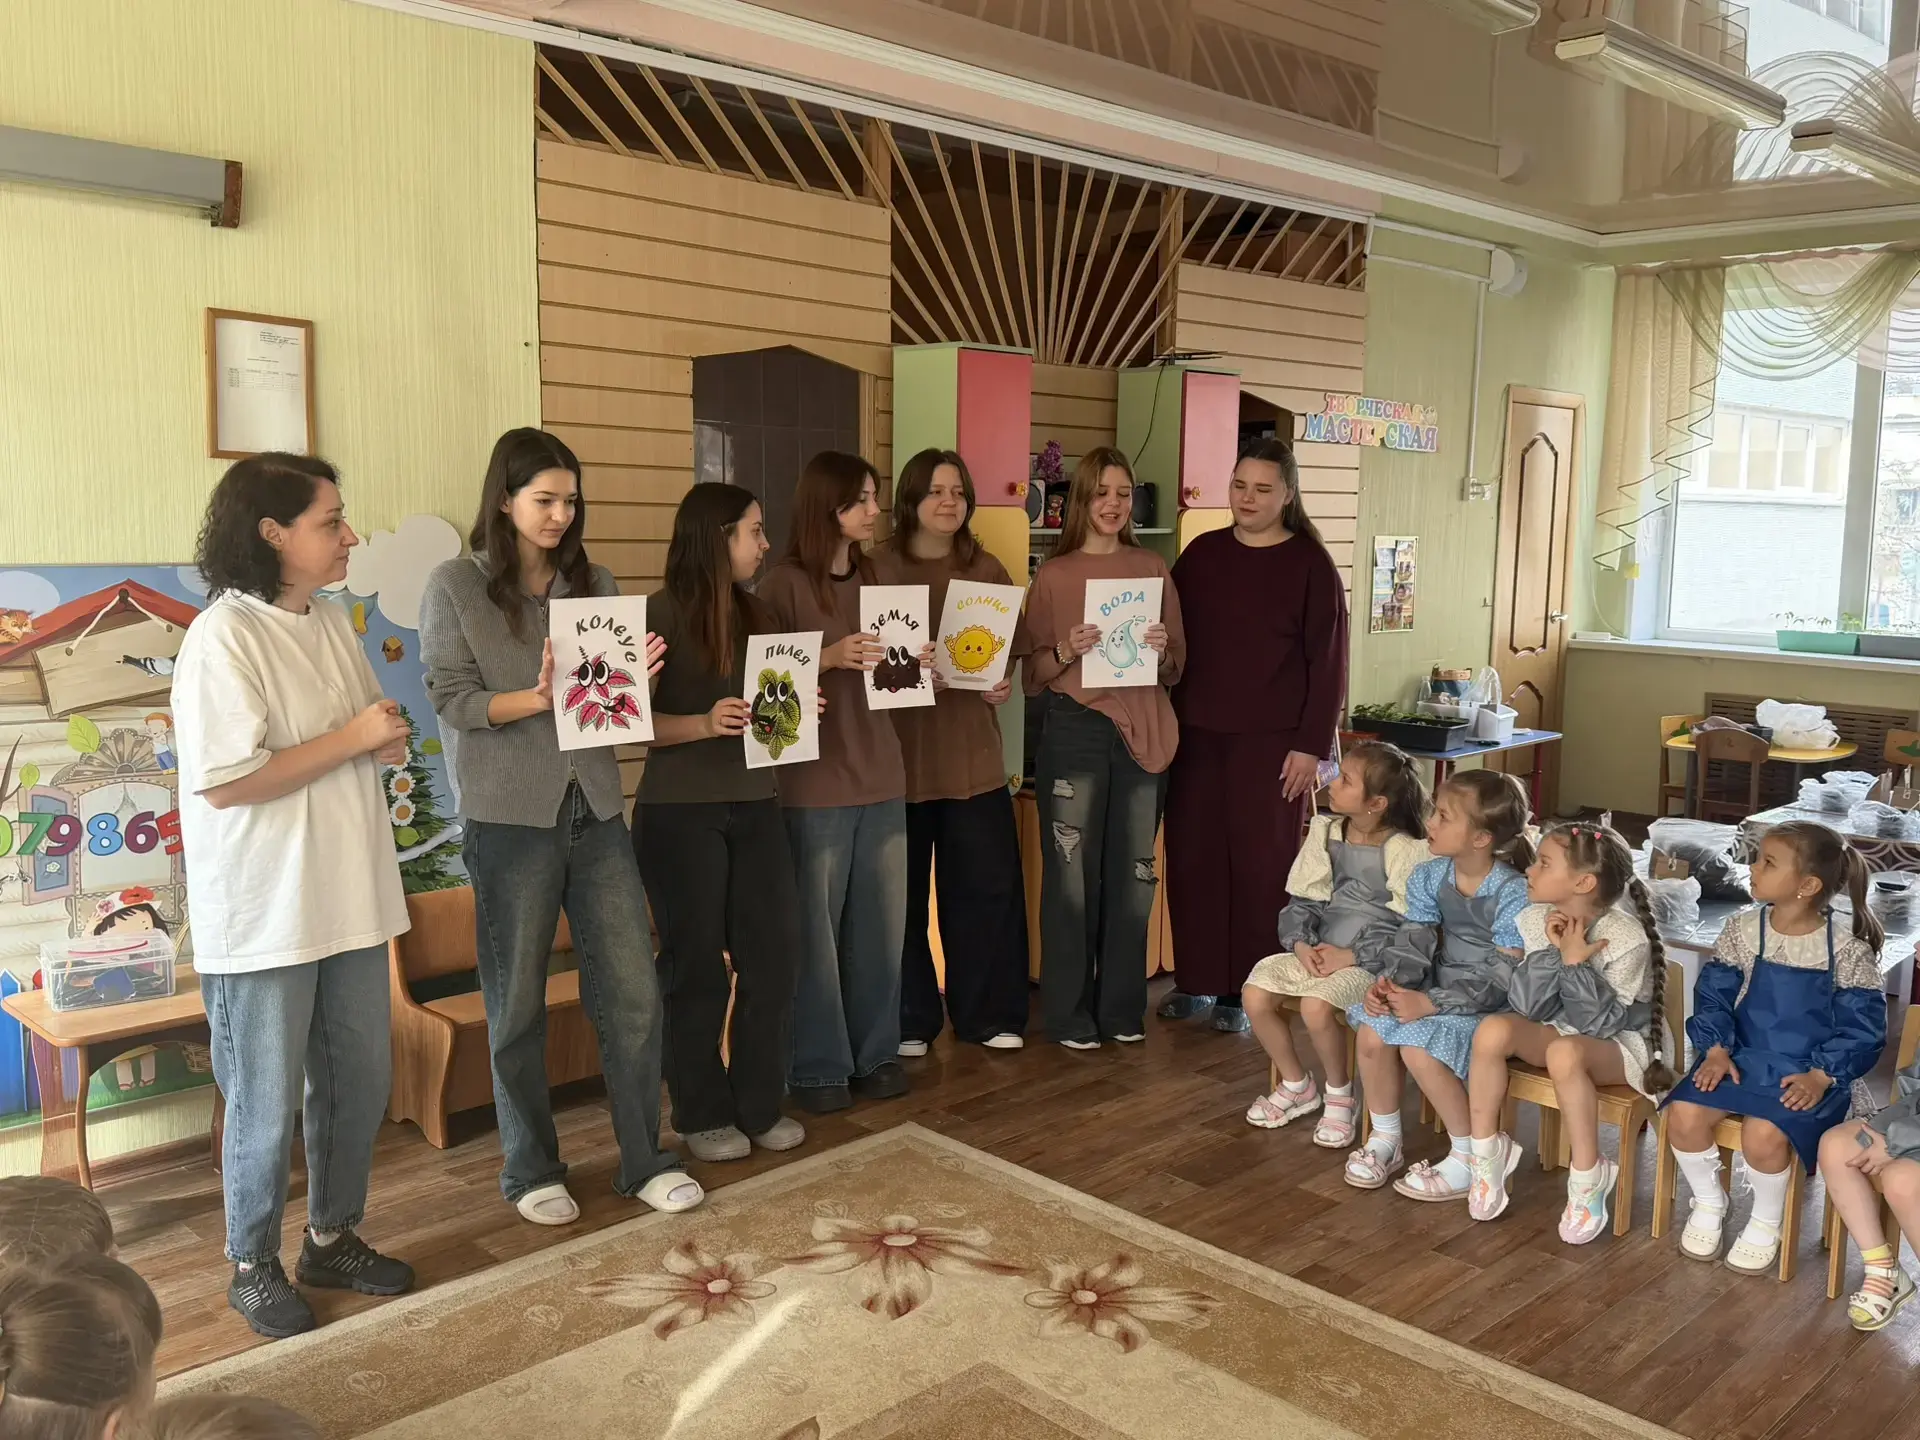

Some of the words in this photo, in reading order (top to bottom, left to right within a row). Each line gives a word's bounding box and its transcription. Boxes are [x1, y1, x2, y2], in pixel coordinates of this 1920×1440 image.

[1326, 393, 1422, 421] ТВОРЧЕСКАЯ
[1306, 413, 1438, 452] МАСТЕРСКАЯ
[957, 595, 1010, 614] СОЛНЦЕ
[1100, 590, 1145, 617] ВОДА
[870, 608, 920, 637] ЗЕМЛЯ
[575, 614, 638, 663] КОЛЕУС
[765, 643, 812, 667] ПИЛЕЯ
